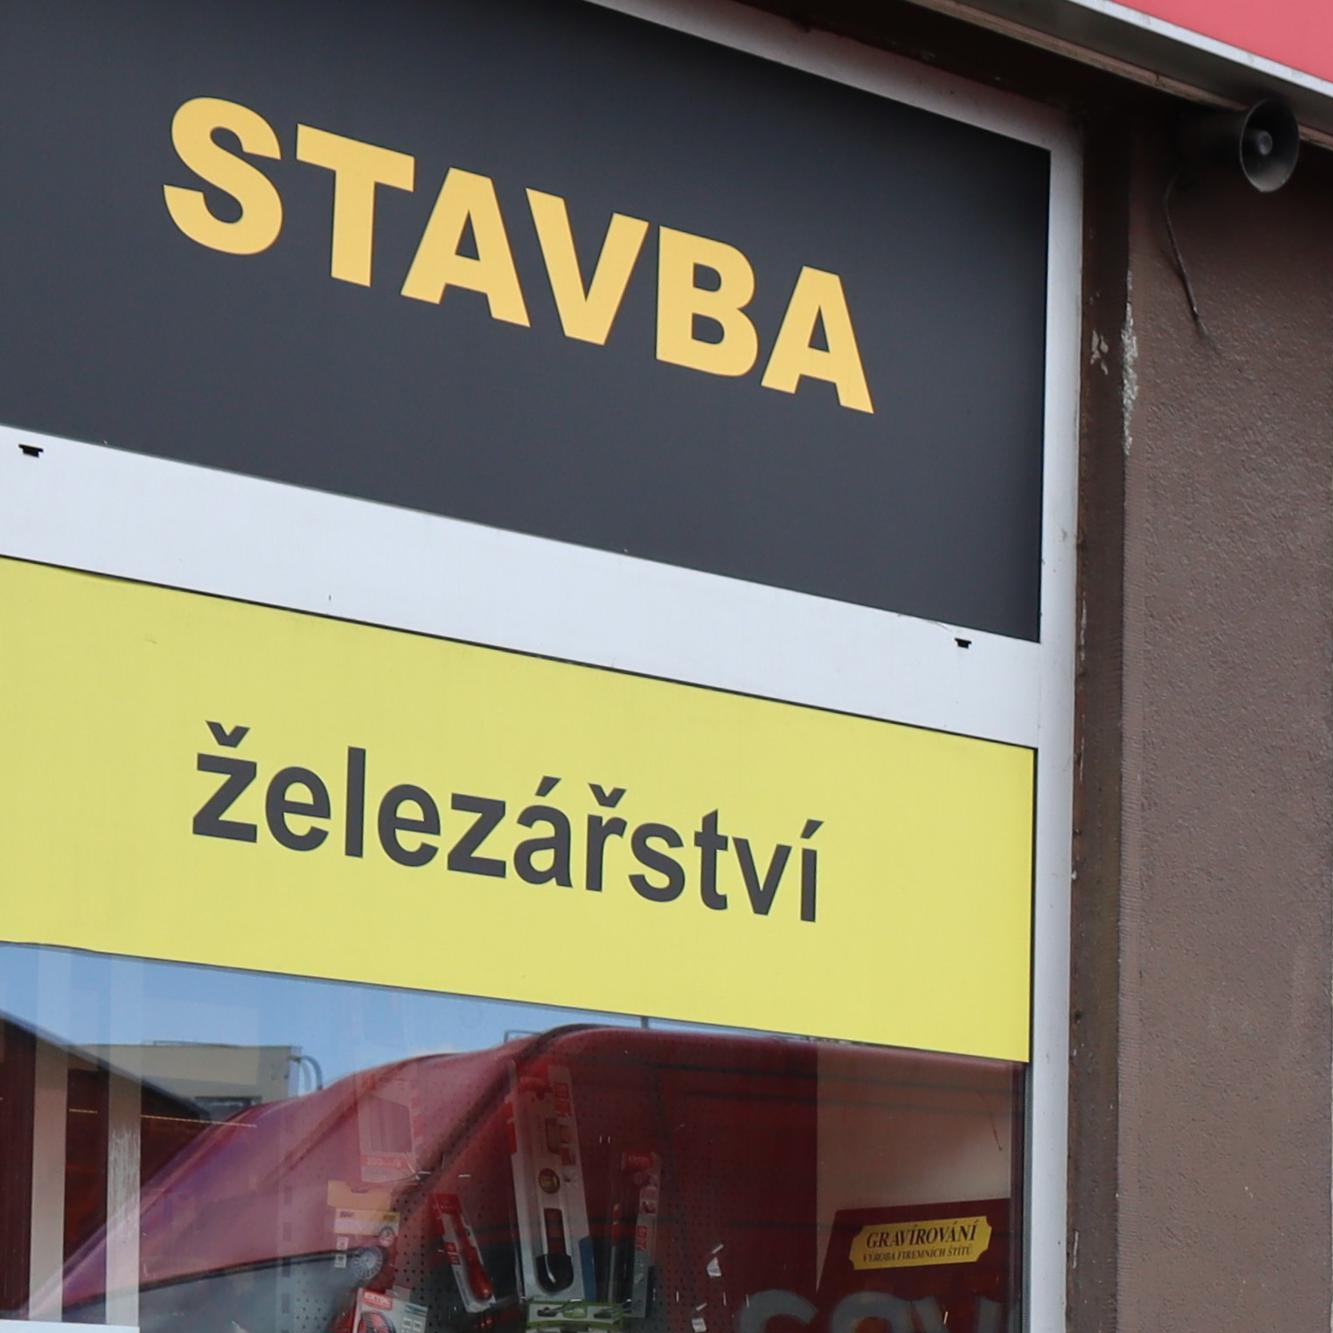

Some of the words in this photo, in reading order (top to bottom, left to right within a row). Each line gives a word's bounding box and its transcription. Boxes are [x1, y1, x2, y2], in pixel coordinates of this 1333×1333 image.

[163, 97, 874, 414] STAVBA
[191, 720, 823, 924] železářství
[866, 1219, 979, 1249] GRAVÍROVÁNÍ
